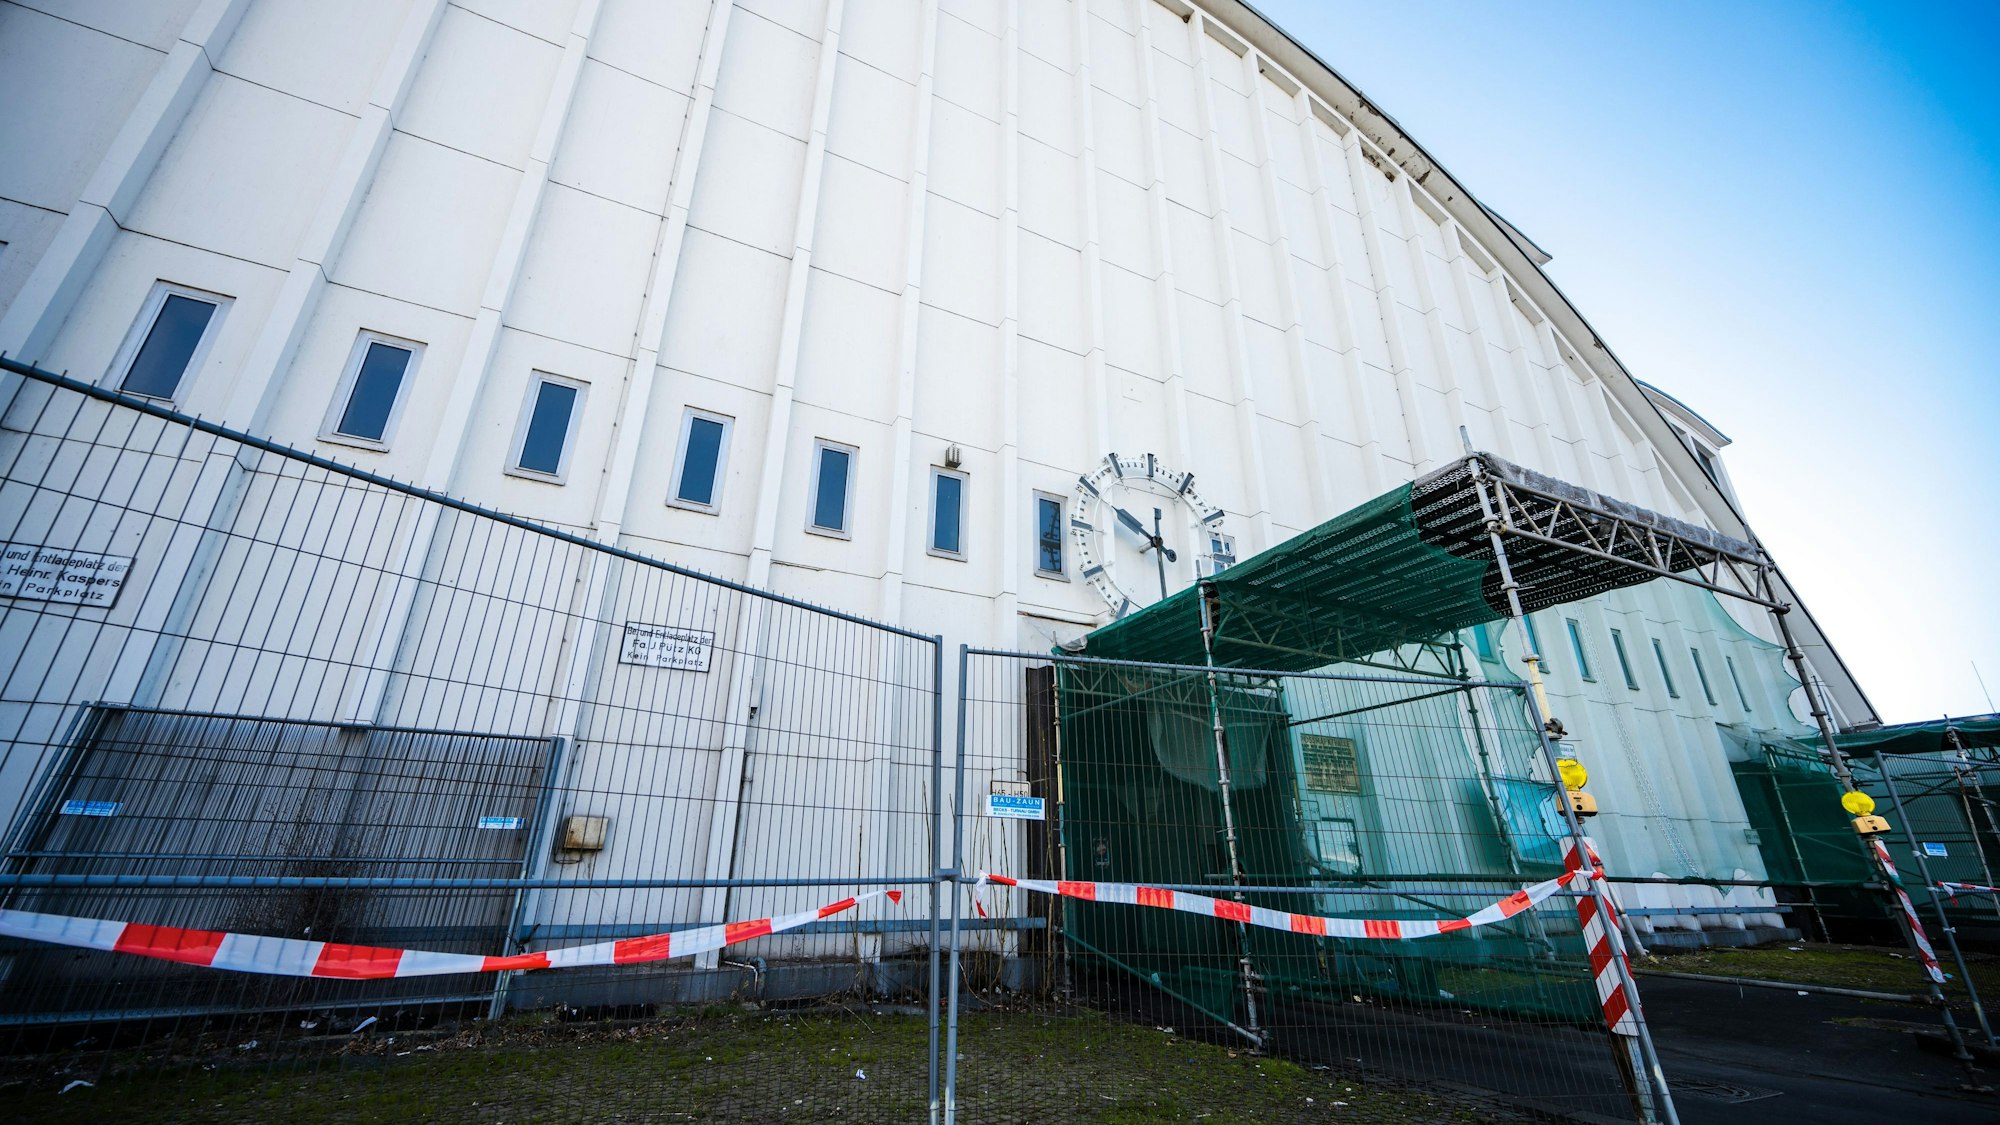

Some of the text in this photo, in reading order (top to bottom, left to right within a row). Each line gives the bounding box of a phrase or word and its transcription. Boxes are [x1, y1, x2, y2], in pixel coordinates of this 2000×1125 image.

[6, 550, 31, 561] und
[107, 561, 129, 572] der
[6, 564, 121, 588] Heinr. Kaspers
[24, 582, 105, 600] Parkplatz
[700, 635, 712, 645] der
[627, 651, 703, 667] Kein Parkplatz
